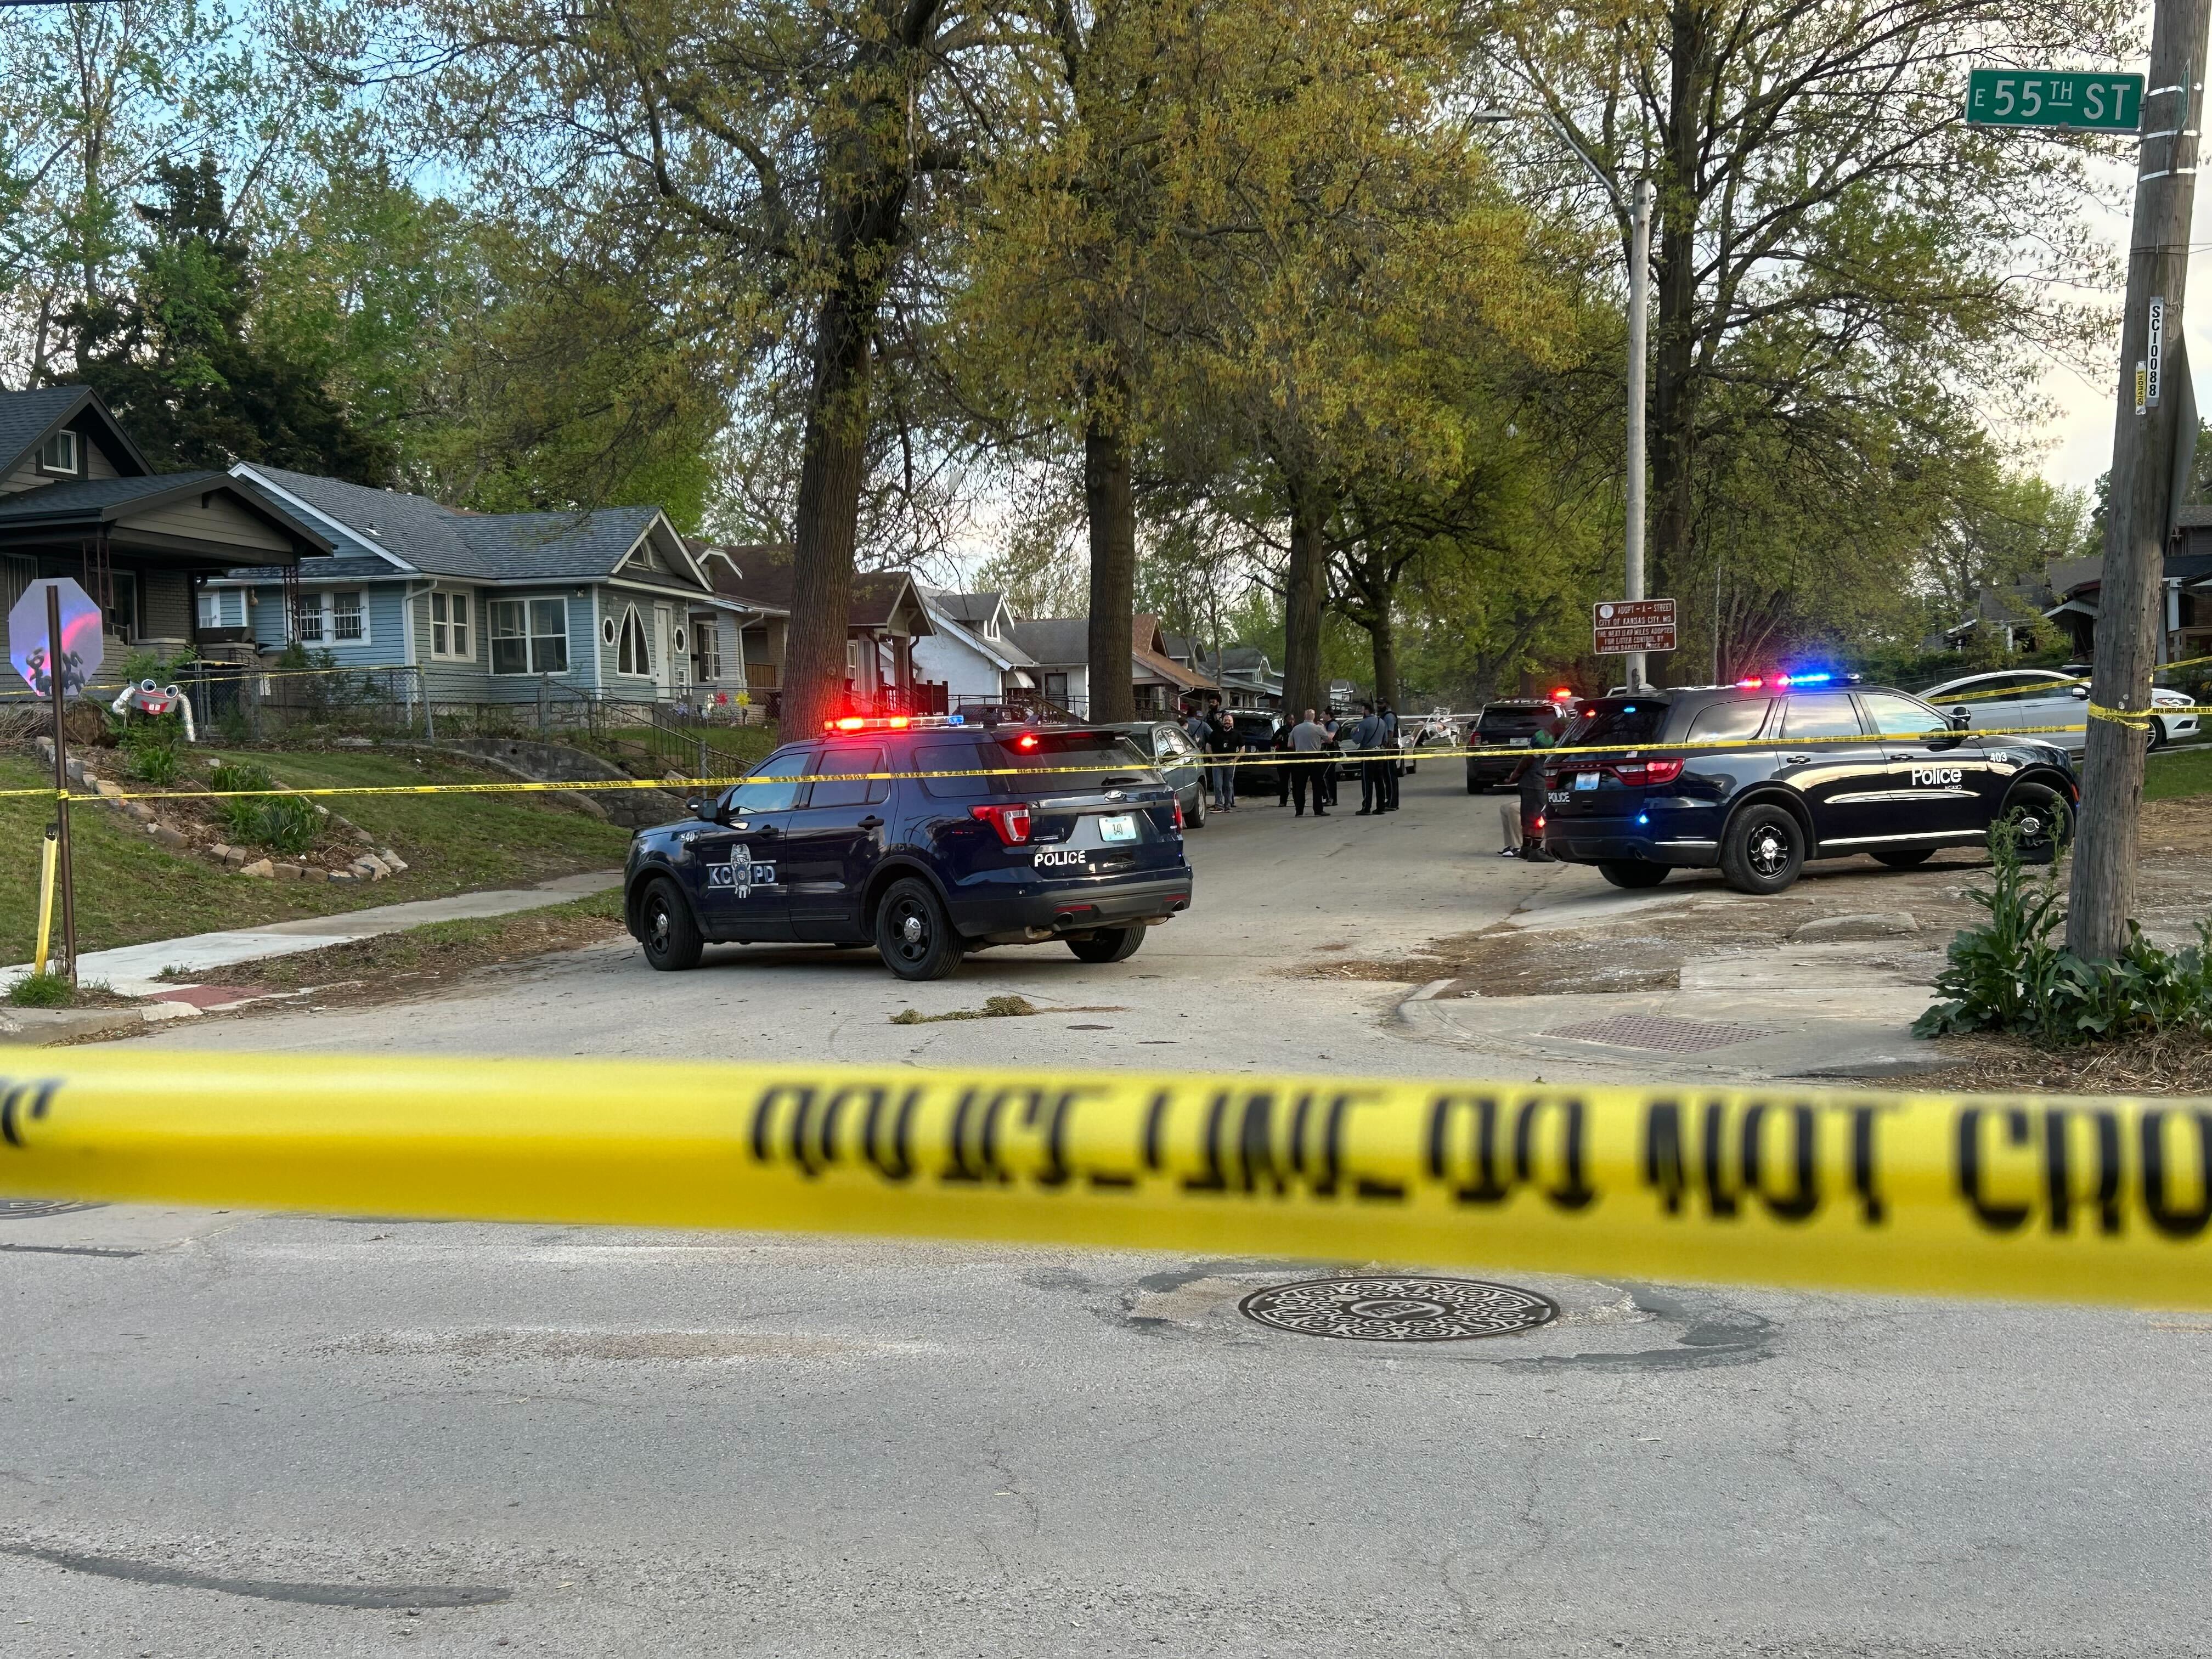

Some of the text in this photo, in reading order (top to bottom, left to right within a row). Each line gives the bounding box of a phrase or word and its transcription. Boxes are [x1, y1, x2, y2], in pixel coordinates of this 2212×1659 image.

[1974, 88, 1985, 106] E
[2084, 83, 2131, 120] ST
[1547, 791, 1571, 803] POLICE
[1034, 850, 1086, 867] POLICE
[1426, 1094, 1596, 1210] DO
[1643, 1096, 1904, 1223] NOT
